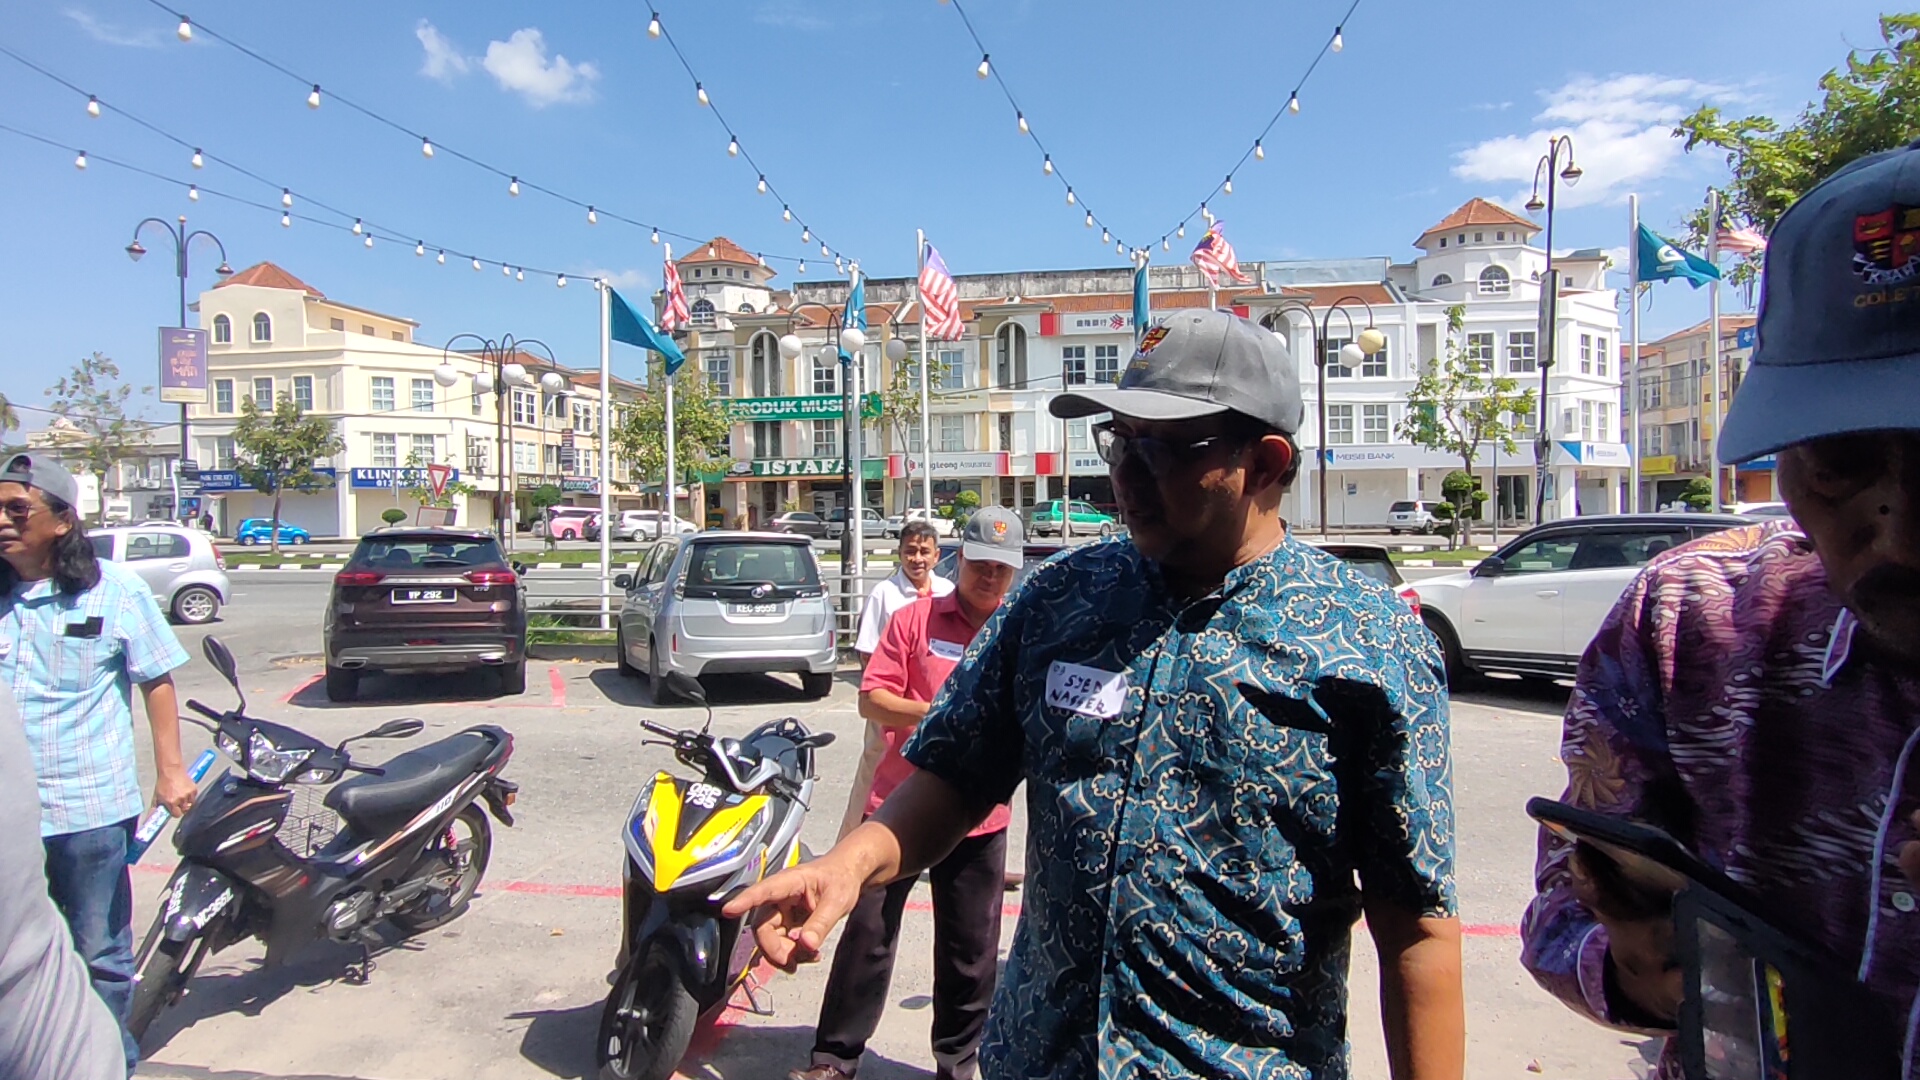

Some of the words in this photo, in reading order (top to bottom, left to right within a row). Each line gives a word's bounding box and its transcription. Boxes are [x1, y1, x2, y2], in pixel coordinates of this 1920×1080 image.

[729, 401, 797, 415] PRODUK
[1367, 452, 1395, 460] BANK
[357, 469, 406, 480] KLINK
[423, 590, 443, 599] 292
[1064, 674, 1104, 694] SYED
[685, 791, 717, 809] 735
